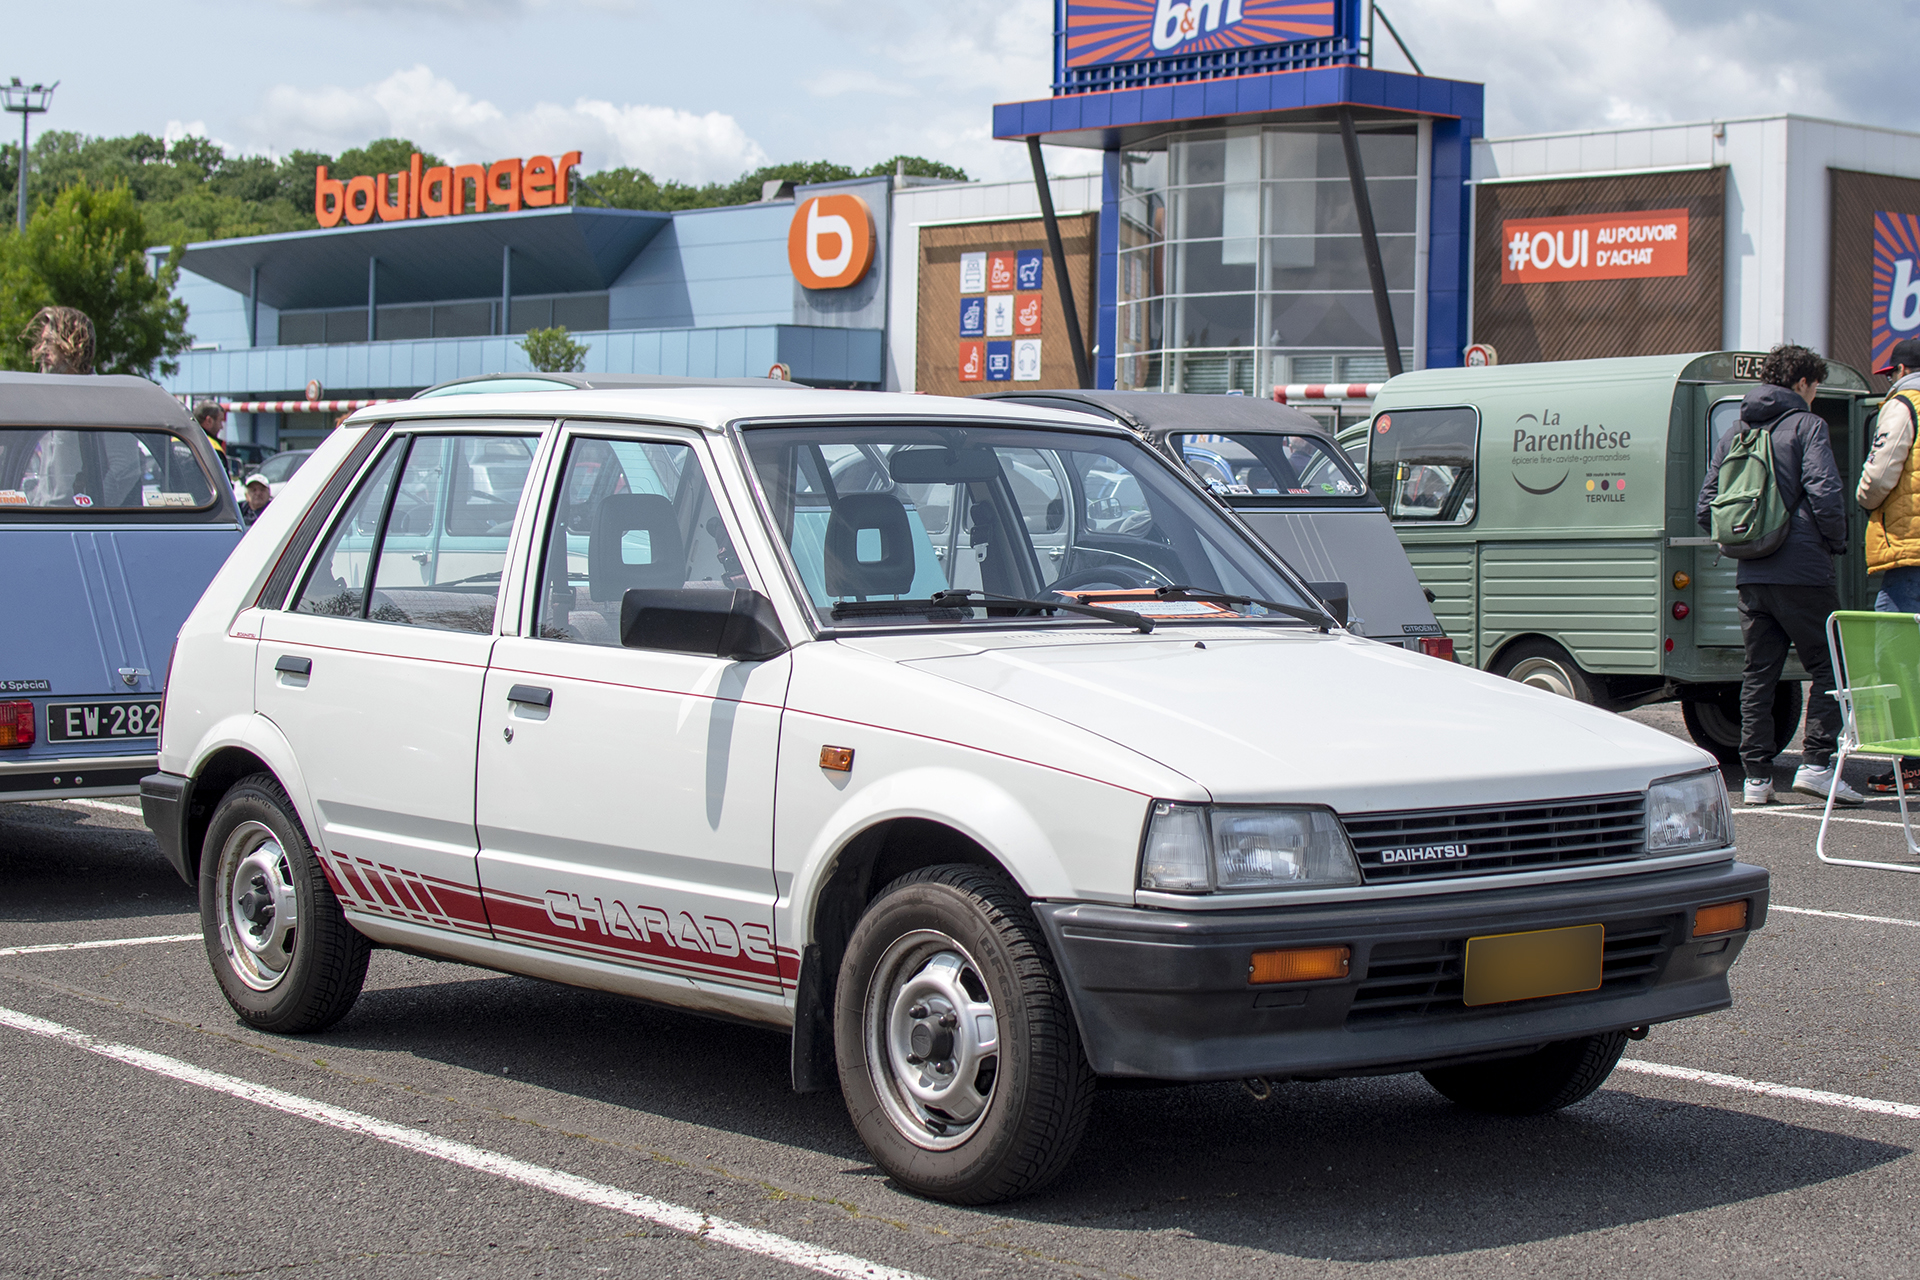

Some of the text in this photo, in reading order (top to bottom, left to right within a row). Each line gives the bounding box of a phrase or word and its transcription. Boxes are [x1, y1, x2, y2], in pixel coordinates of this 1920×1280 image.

[1152, 0, 1243, 51] b&m
[315, 151, 581, 228] boulanger
[1508, 224, 1677, 271] #OUI AU POUVOIR
[1596, 248, 1654, 267] D'ACHAT
[1542, 409, 1560, 426] La
[1513, 424, 1631, 452] Parenthèse
[1511, 452, 1631, 466] épicerie fine caviste gourmandises
[1585, 494, 1625, 503] TERVILLE
[8, 680, 48, 691] Spécial
[1382, 844, 1467, 863] DAIHATSU
[545, 889, 776, 964] CHARADE
